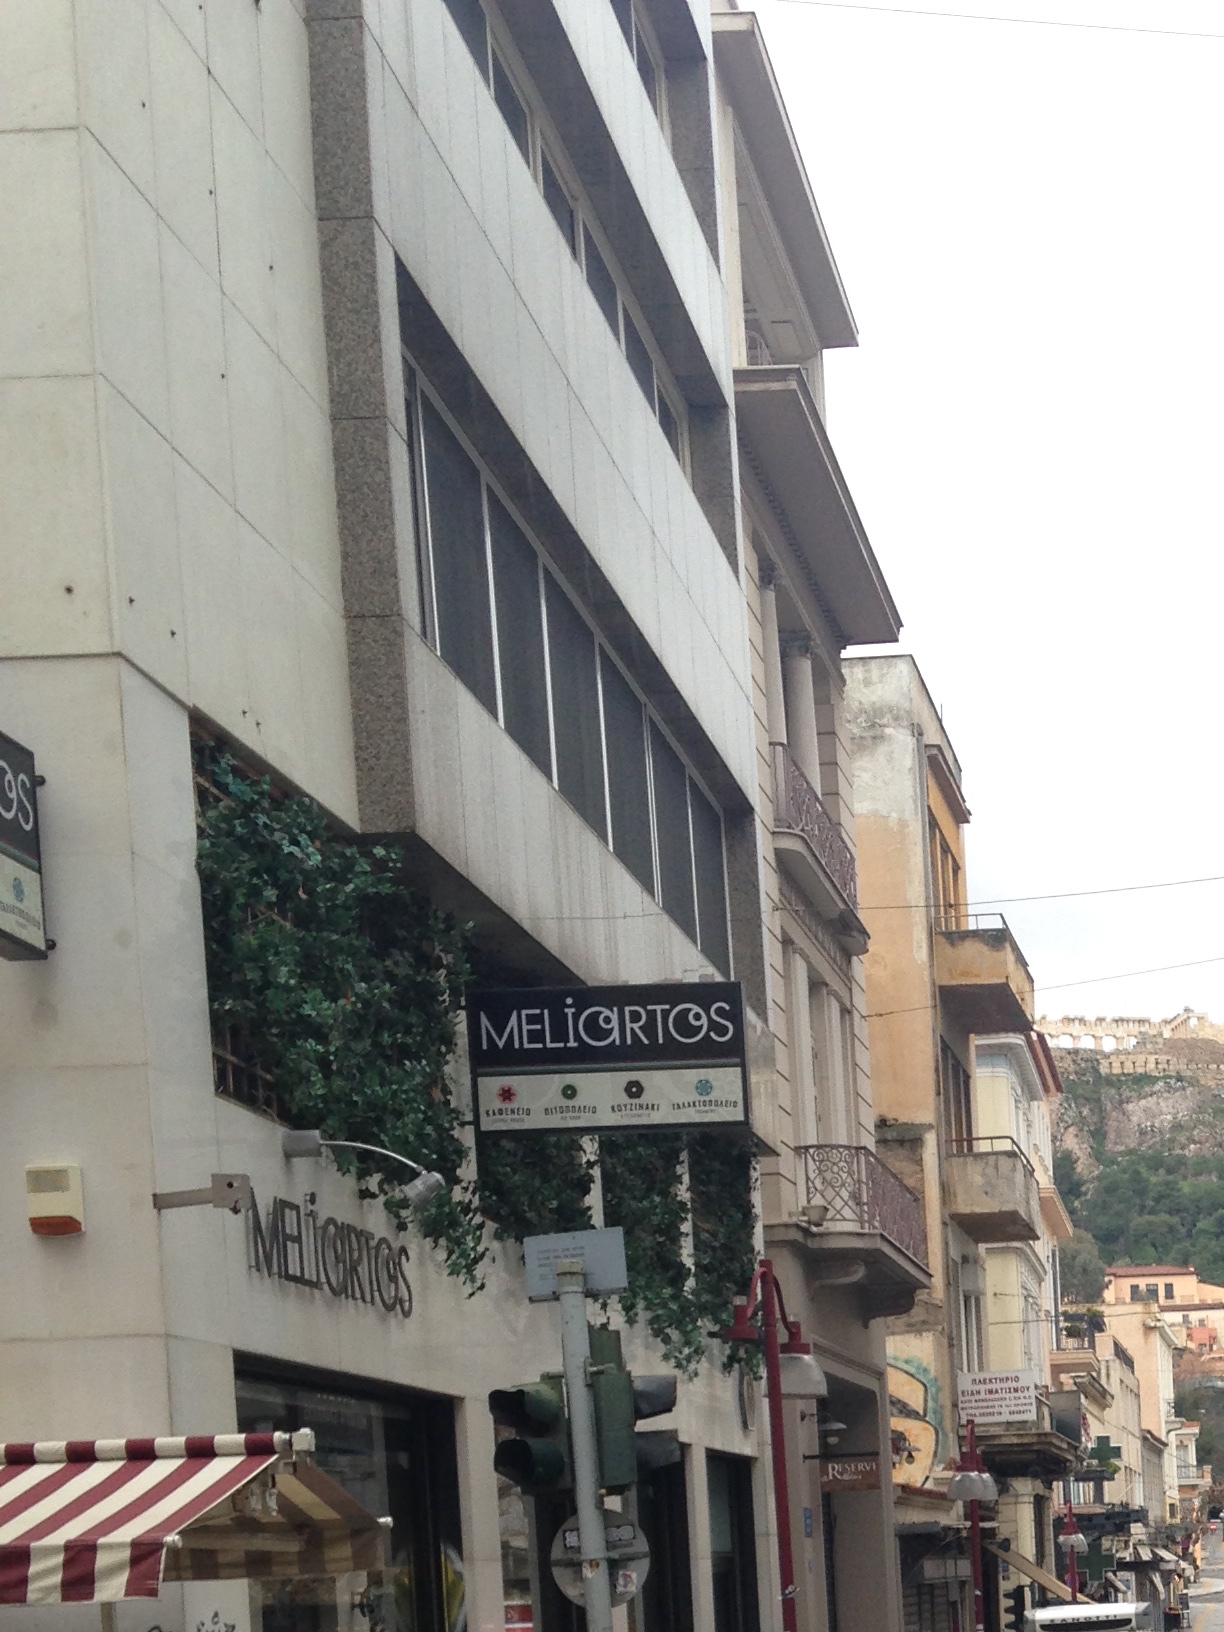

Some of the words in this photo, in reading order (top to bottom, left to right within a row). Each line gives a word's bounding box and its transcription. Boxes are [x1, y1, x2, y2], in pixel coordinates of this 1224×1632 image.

[971, 1375, 1020, 1386] ΠΛΕΚΤΗΡΙΟ
[961, 1389, 981, 1397] ΕΙΔΗ
[984, 1385, 1031, 1396] ΙΜΑΤΙΣΜΟΥ
